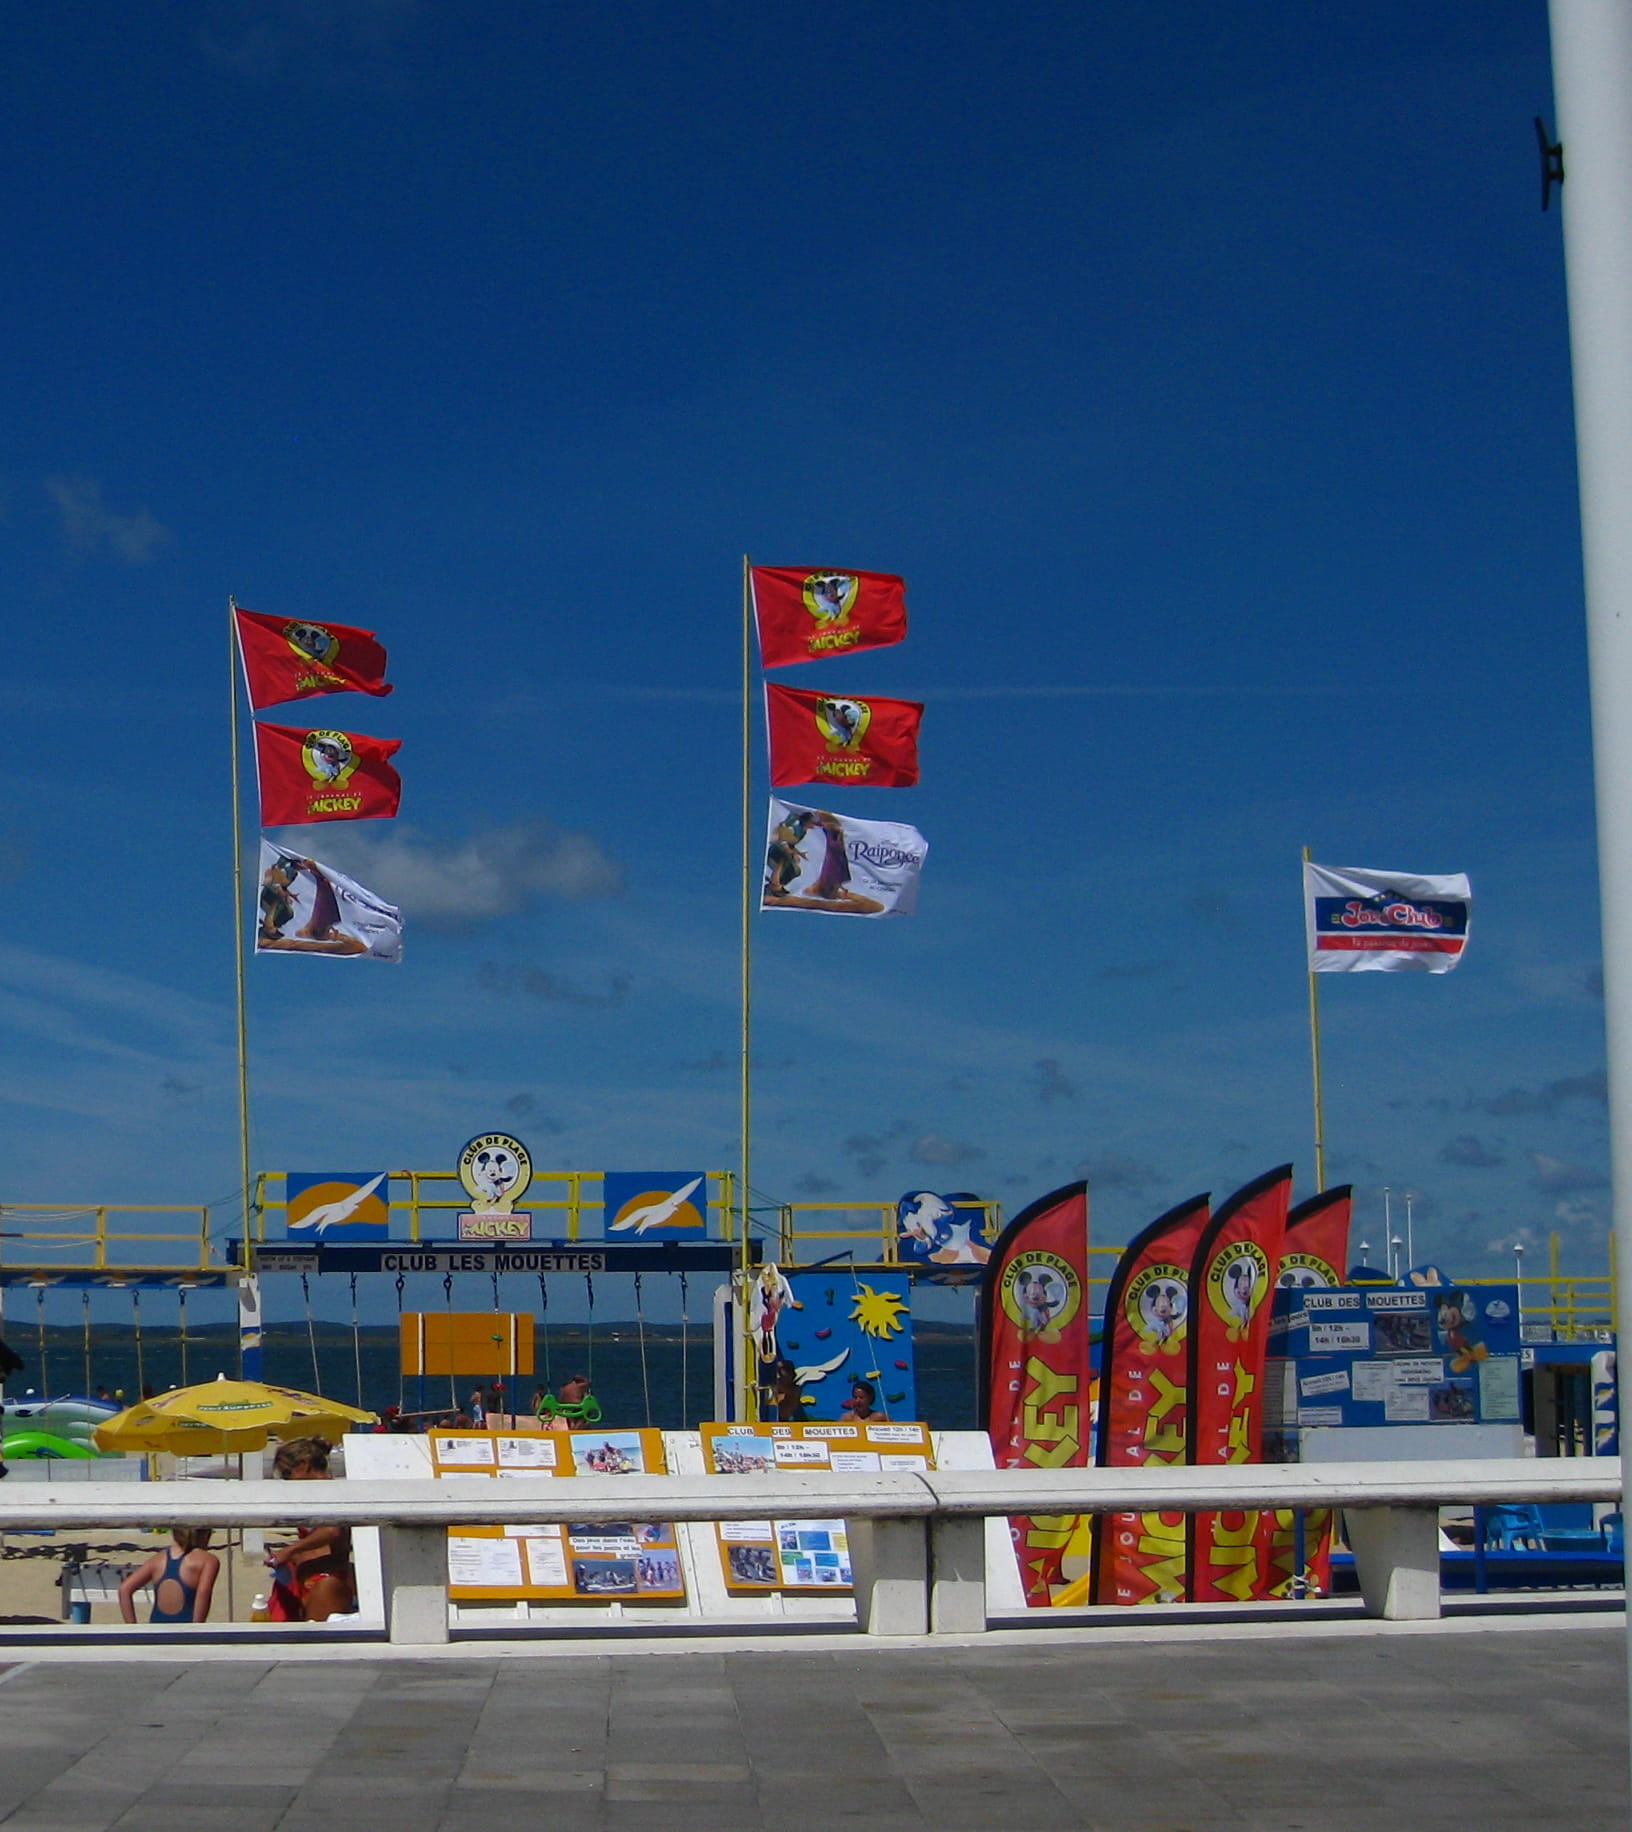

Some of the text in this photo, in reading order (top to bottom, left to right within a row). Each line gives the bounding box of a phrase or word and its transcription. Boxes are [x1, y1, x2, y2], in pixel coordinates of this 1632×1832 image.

[848, 840, 920, 869] Raiponce
[463, 1136, 528, 1166] CLUB DE PLAGE
[384, 1255, 603, 1271] CLUB LES MOUETTES
[1003, 1253, 1077, 1288] CLUB DE PLAGE
[1210, 1250, 1233, 1282] CLUB
[1290, 1255, 1306, 1264] DE
[1128, 1271, 1152, 1300] CLUB
[1154, 1266, 1168, 1275] DE
[1303, 1295, 1425, 1308] CLUB DES MOUETTES
[1009, 1360, 1021, 1391] DE
[1128, 1370, 1142, 1401] DE
[1218, 1361, 1230, 1395] DE
[728, 1427, 754, 1435] CLUB
[804, 1427, 856, 1436] MOUETTES
